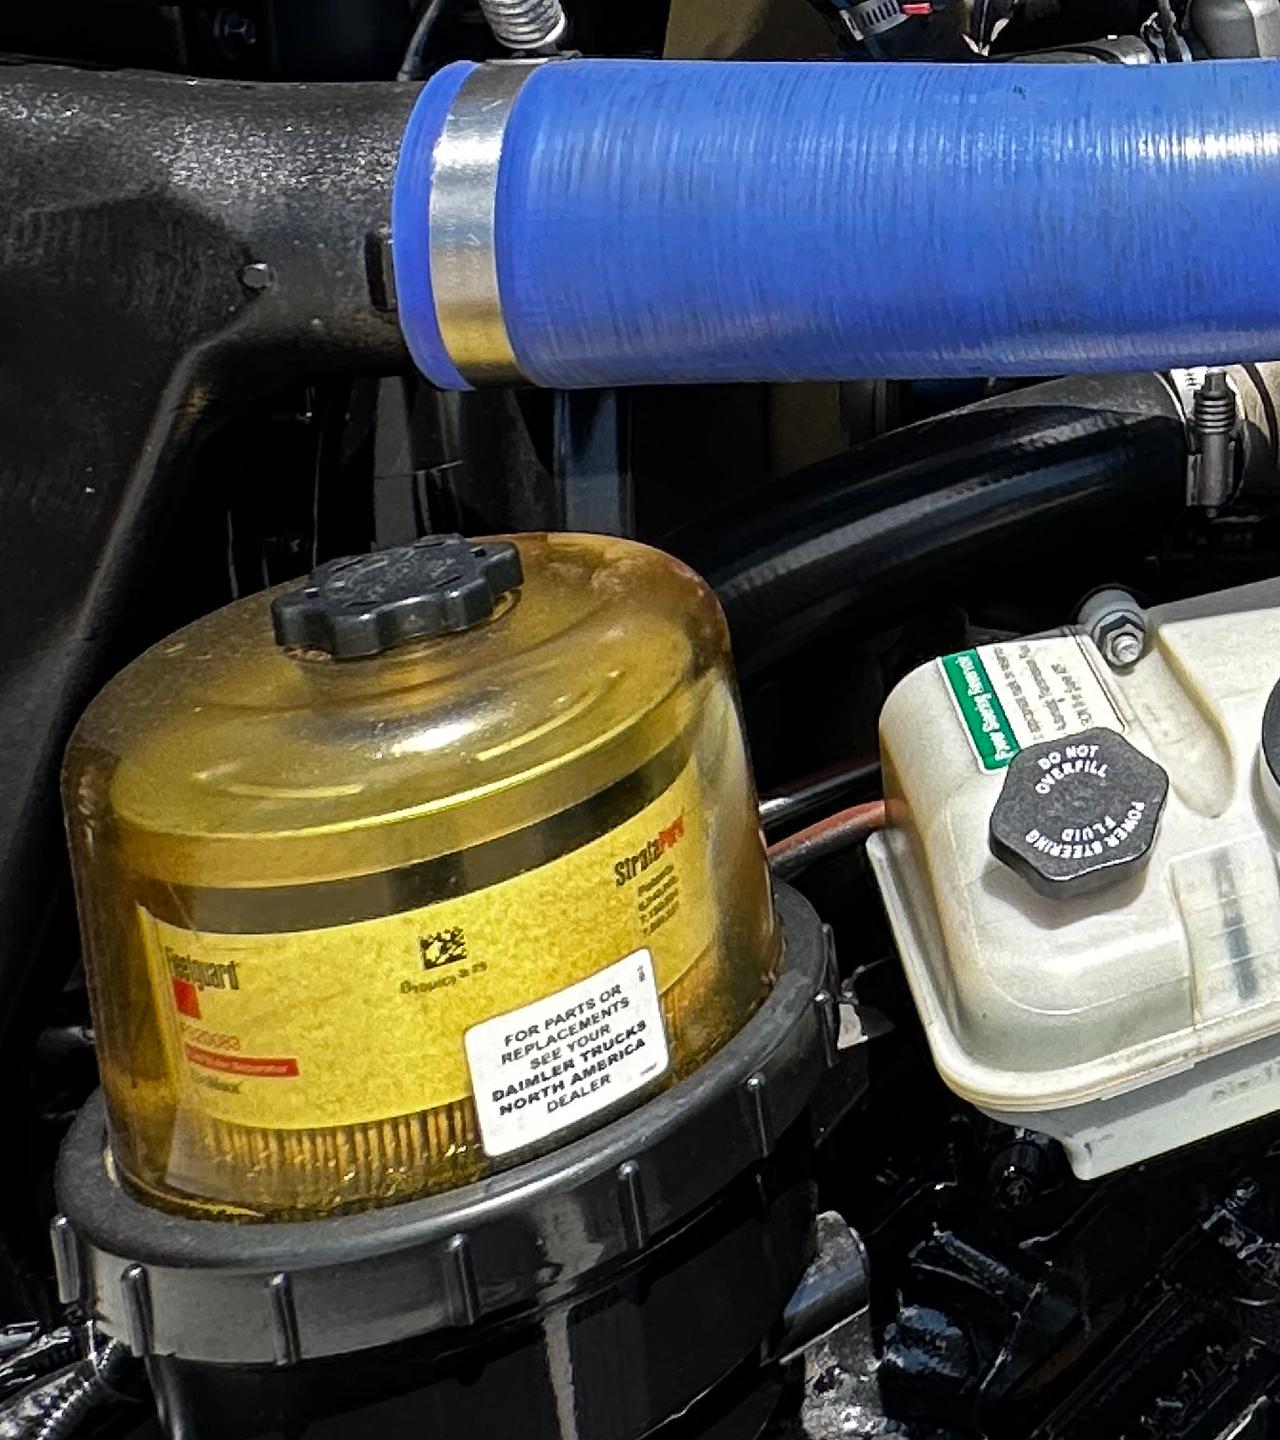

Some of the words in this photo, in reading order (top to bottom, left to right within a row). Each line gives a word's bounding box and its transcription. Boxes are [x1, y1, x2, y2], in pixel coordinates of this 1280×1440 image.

[1035, 759, 1109, 794] OVERFILL
[1037, 751, 1061, 770] DO
[1065, 743, 1100, 759] NOT
[1025, 829, 1103, 859] STEERING
[1061, 815, 1116, 842] FLUID
[1103, 801, 1146, 848] POWER
[501, 996, 631, 1066] REPLACEMENTS
[504, 1024, 541, 1048] FOR
[544, 997, 597, 1031] PARTS
[599, 983, 623, 1004] OR
[492, 1057, 576, 1103] DAIMLER
[579, 1019, 647, 1063] TRUCKS
[530, 1046, 563, 1070] SEE
[566, 1022, 611, 1053] YOUR
[499, 1079, 565, 1116] NORTH
[570, 1037, 646, 1086] AMERICA
[547, 1073, 612, 1114] DEALER
